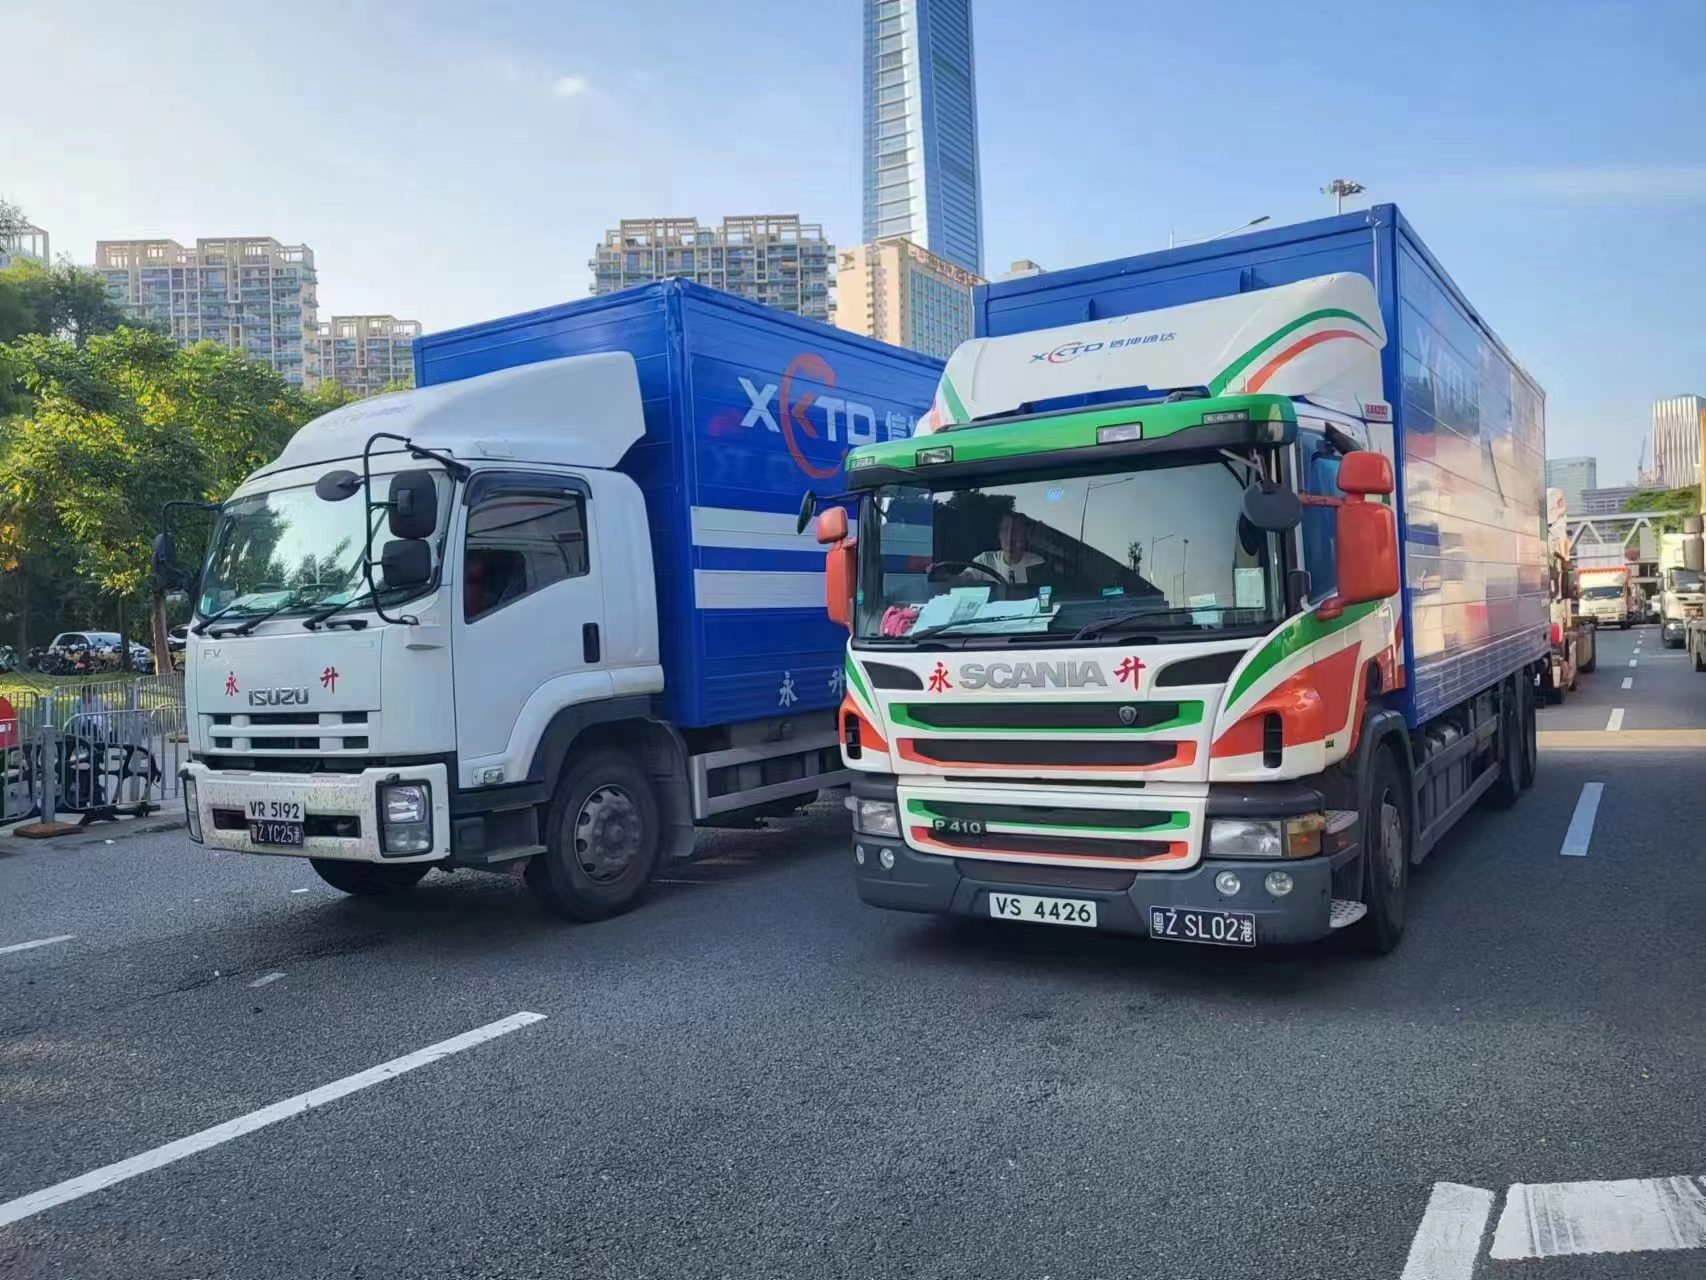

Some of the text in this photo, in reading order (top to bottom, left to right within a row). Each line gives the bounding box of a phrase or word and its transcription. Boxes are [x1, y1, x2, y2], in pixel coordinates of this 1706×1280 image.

[203, 649, 222, 659] FV
[928, 656, 1147, 693] 永 SCANIA 升
[225, 666, 339, 706] 永 ISUZU 升
[250, 801, 299, 819] VR 5192
[935, 820, 981, 834] P 410
[996, 896, 1091, 923] VS 4426
